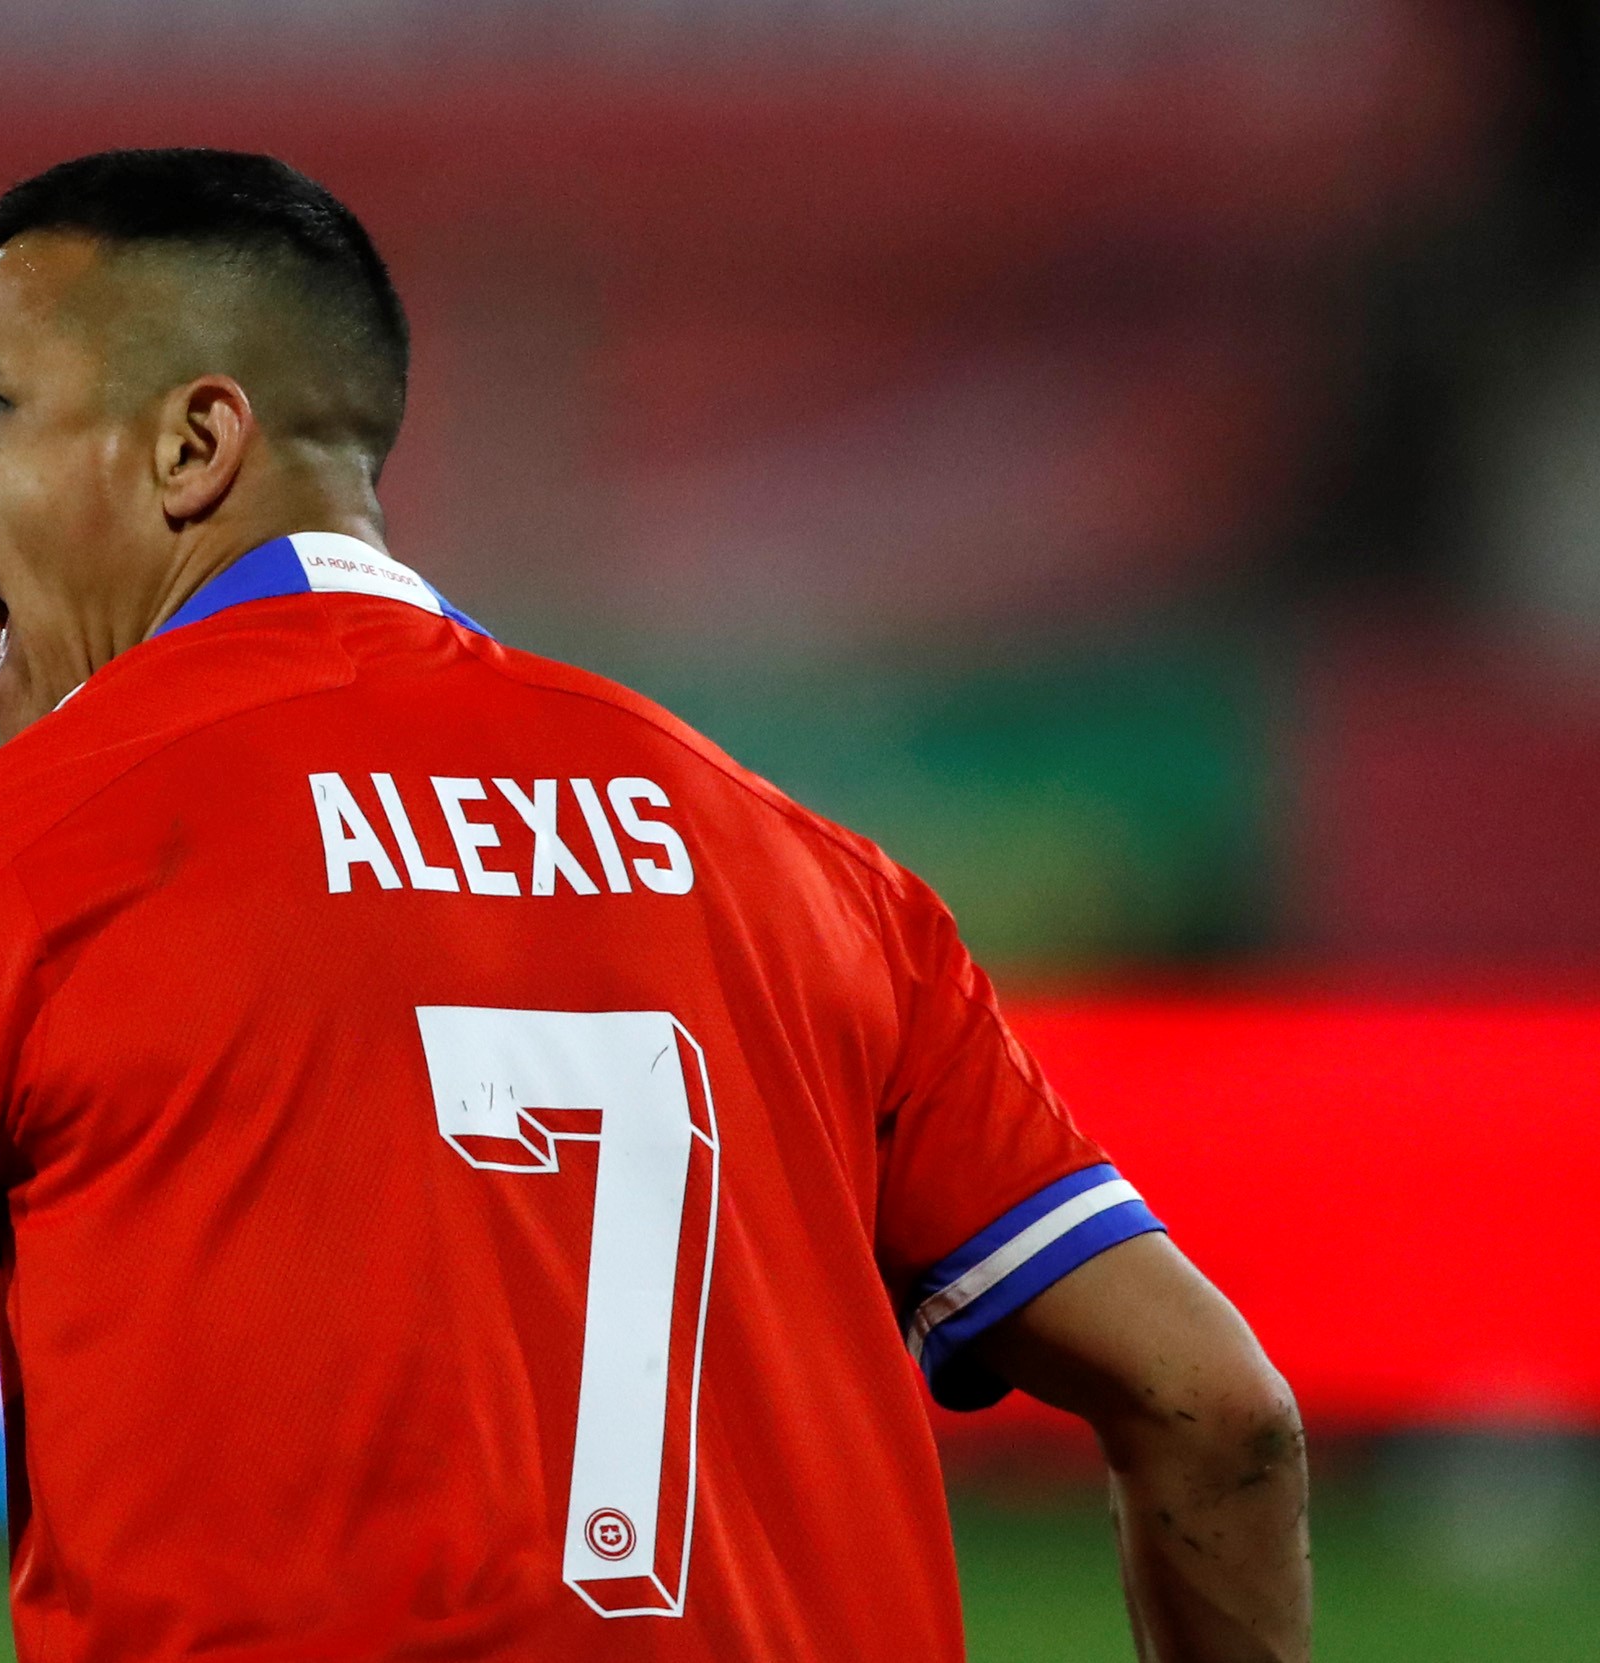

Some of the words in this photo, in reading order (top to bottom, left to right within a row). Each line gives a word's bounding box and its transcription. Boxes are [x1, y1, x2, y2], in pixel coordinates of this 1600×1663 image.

[306, 556, 325, 567] LA
[327, 557, 358, 573] ROJA
[360, 563, 378, 576] DE
[308, 772, 695, 896] ALEXIS
[415, 1006, 719, 1618] 7
